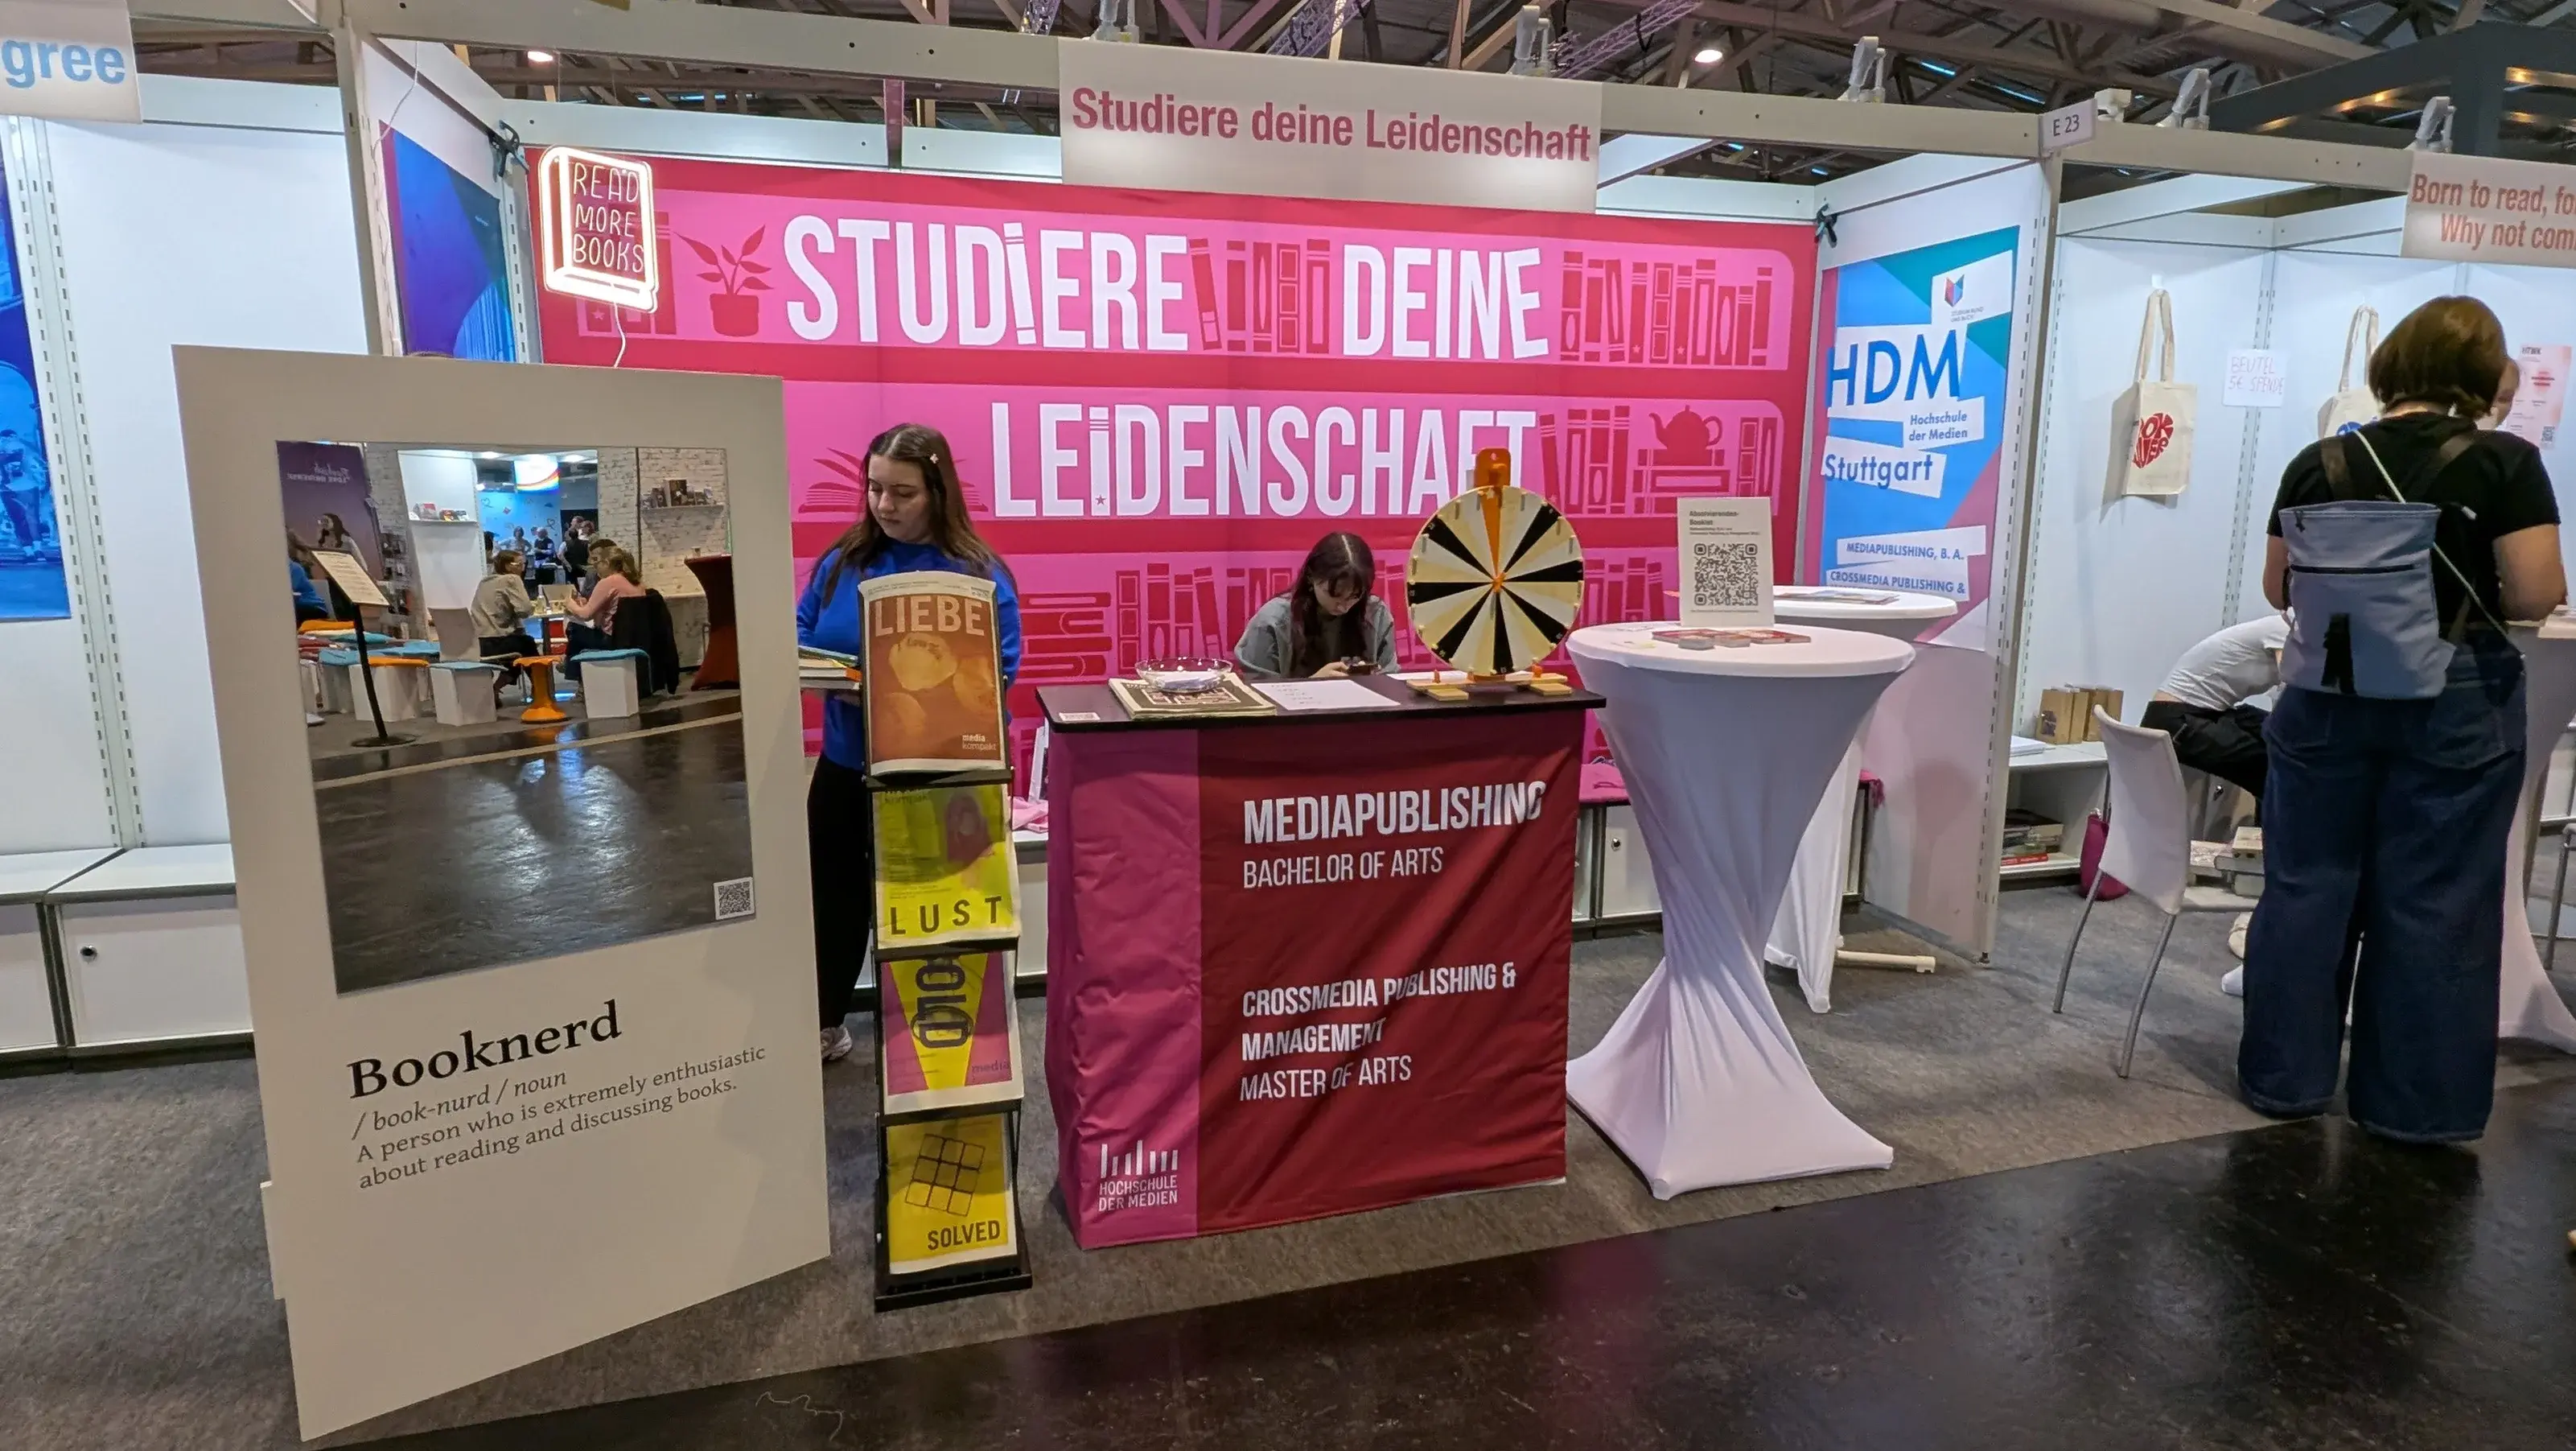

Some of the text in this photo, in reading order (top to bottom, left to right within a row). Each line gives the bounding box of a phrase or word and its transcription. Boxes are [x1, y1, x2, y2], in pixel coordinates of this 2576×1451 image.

[1072, 87, 1591, 162] Studiere deine Leidenschaft
[2053, 113, 2080, 137] E 23
[574, 162, 640, 203] READ
[2412, 174, 2576, 219] Born to read, fo
[575, 203, 636, 237] MORE
[2441, 213, 2576, 251] Why not com
[572, 233, 644, 273] BOOKS
[784, 214, 1549, 361] STUDIERE DEINE
[1825, 328, 1961, 408] HDM
[1908, 429, 1968, 441] der Medien
[1910, 410, 1968, 426] Hochschule
[1824, 453, 1933, 489] Stuttgart
[1846, 542, 1937, 560] MEDIAPUBLISHING,
[1829, 571, 1890, 587] CROSSMEDIA
[1891, 576, 1954, 593] PUBLISHING
[1956, 582, 1965, 594] &
[874, 595, 985, 637] LIEBE
[962, 733, 986, 742] media
[1244, 781, 1546, 844] MEDIAPUBLISHING
[1243, 847, 1444, 888] BACHELOR OF ARTS
[890, 896, 1002, 935] LUST
[1243, 962, 1516, 1017] CROSSMEDIA PUBLISHING &
[347, 999, 623, 1099] Booknerd
[1242, 1017, 1386, 1061] MANAGEMENT
[1240, 1055, 1412, 1101] MASTER OF ARTS
[357, 1046, 765, 1163] A person who is extremely enthusiastic
[373, 1083, 490, 1131] book-nurd
[514, 1072, 567, 1097] noun
[360, 1078, 737, 1189] about reading and discussing books.
[1099, 1175, 1178, 1196] HOCHSCHULE
[1099, 1190, 1178, 1211] DER MEDIEN
[927, 1219, 1001, 1251] SOLVED
